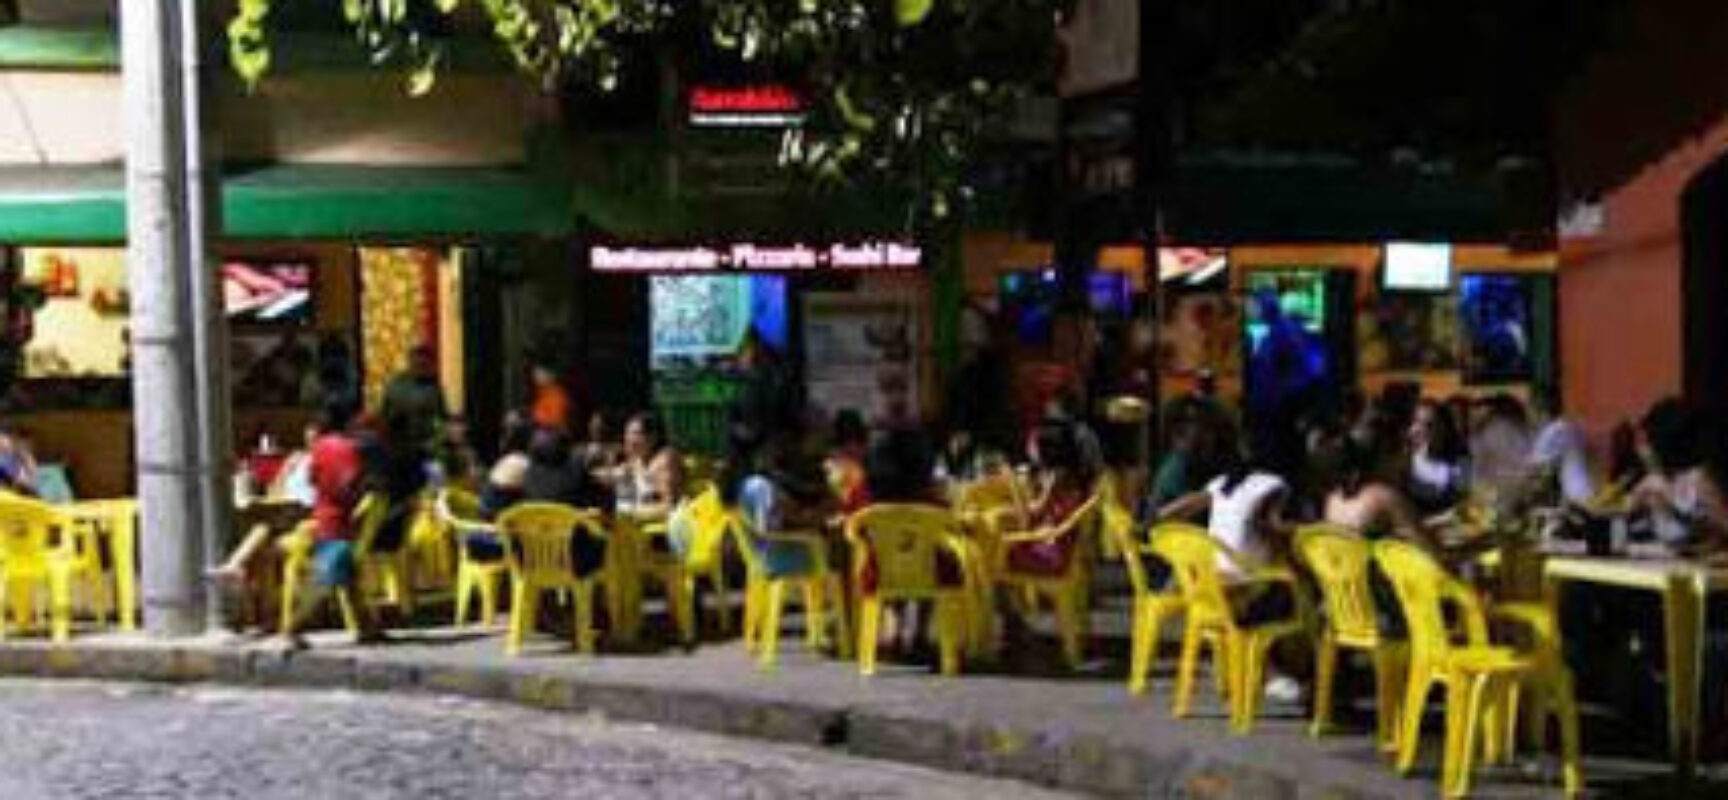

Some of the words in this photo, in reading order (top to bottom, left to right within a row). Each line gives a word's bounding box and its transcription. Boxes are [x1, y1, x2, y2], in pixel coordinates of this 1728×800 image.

[591, 246, 717, 269] Restaurante
[732, 243, 816, 268] Pizzaria
[831, 243, 881, 267] Sushi
[886, 243, 921, 266] Bar
